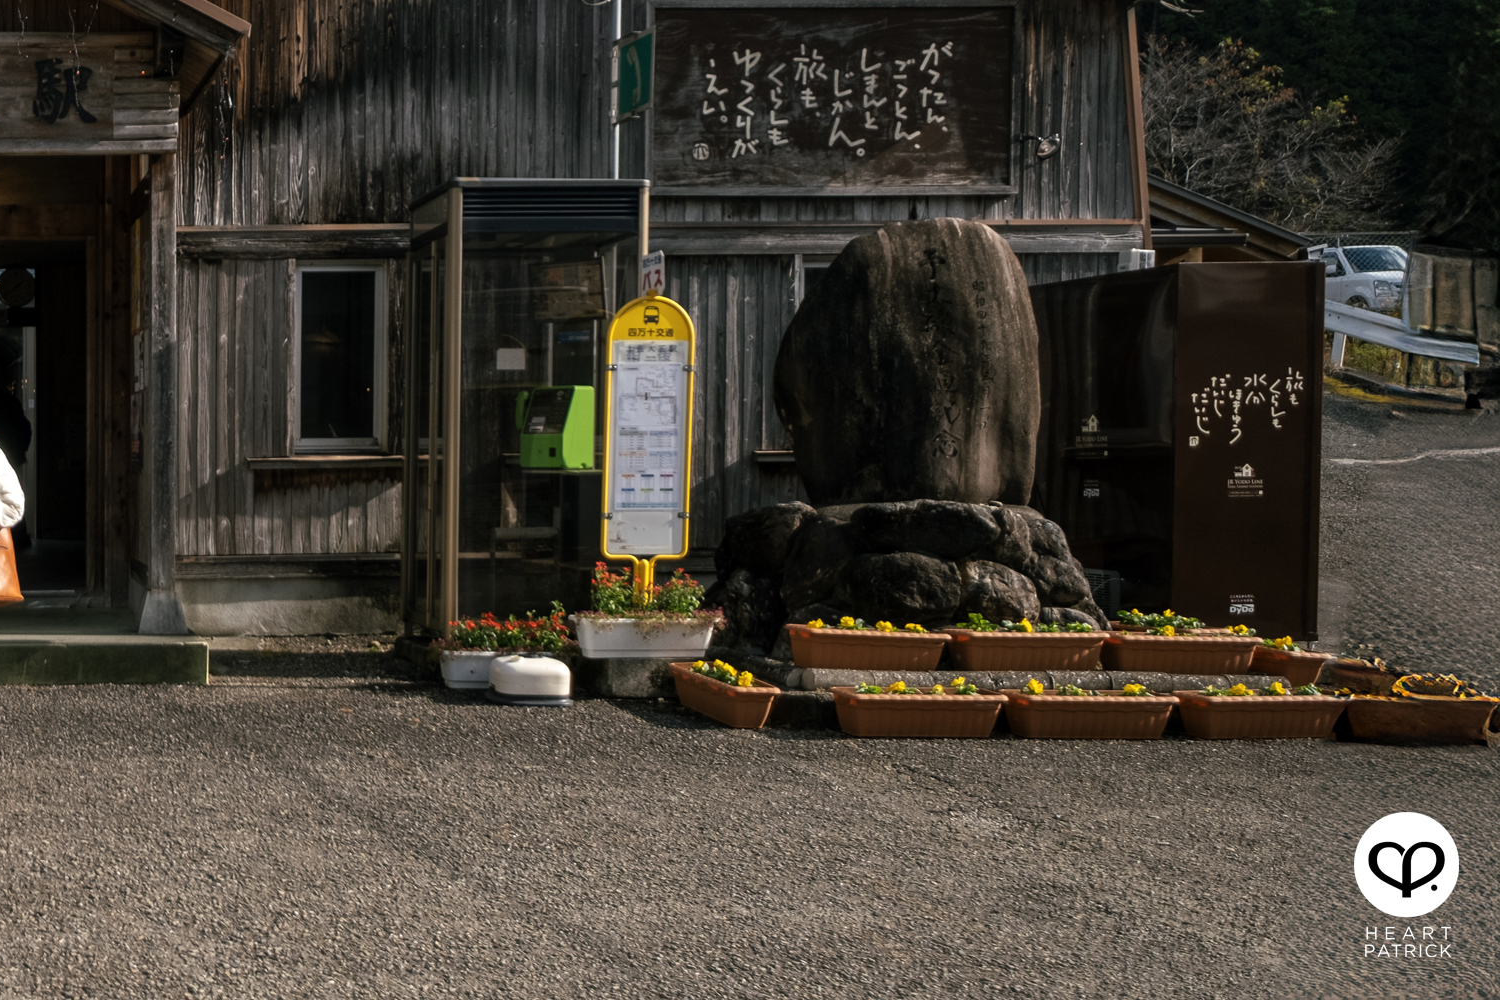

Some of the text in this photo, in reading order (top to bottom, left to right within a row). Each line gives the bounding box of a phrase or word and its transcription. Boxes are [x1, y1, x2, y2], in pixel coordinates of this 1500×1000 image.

[702, 58, 729, 123] えい。
[732, 48, 762, 158] ゆっくりが
[767, 62, 789, 146] くらしも
[828, 68, 866, 157] じかん。
[861, 48, 888, 130] しまんと
[628, 327, 674, 338] 四万十交通
[1191, 386, 1210, 435] だいじ
[1211, 373, 1231, 418] だいじ
[1269, 378, 1286, 428] くらしも
[1286, 366, 1304, 405] 旅も
[1228, 388, 1242, 445] ほきゅう
[1229, 604, 1255, 615] DyDo
